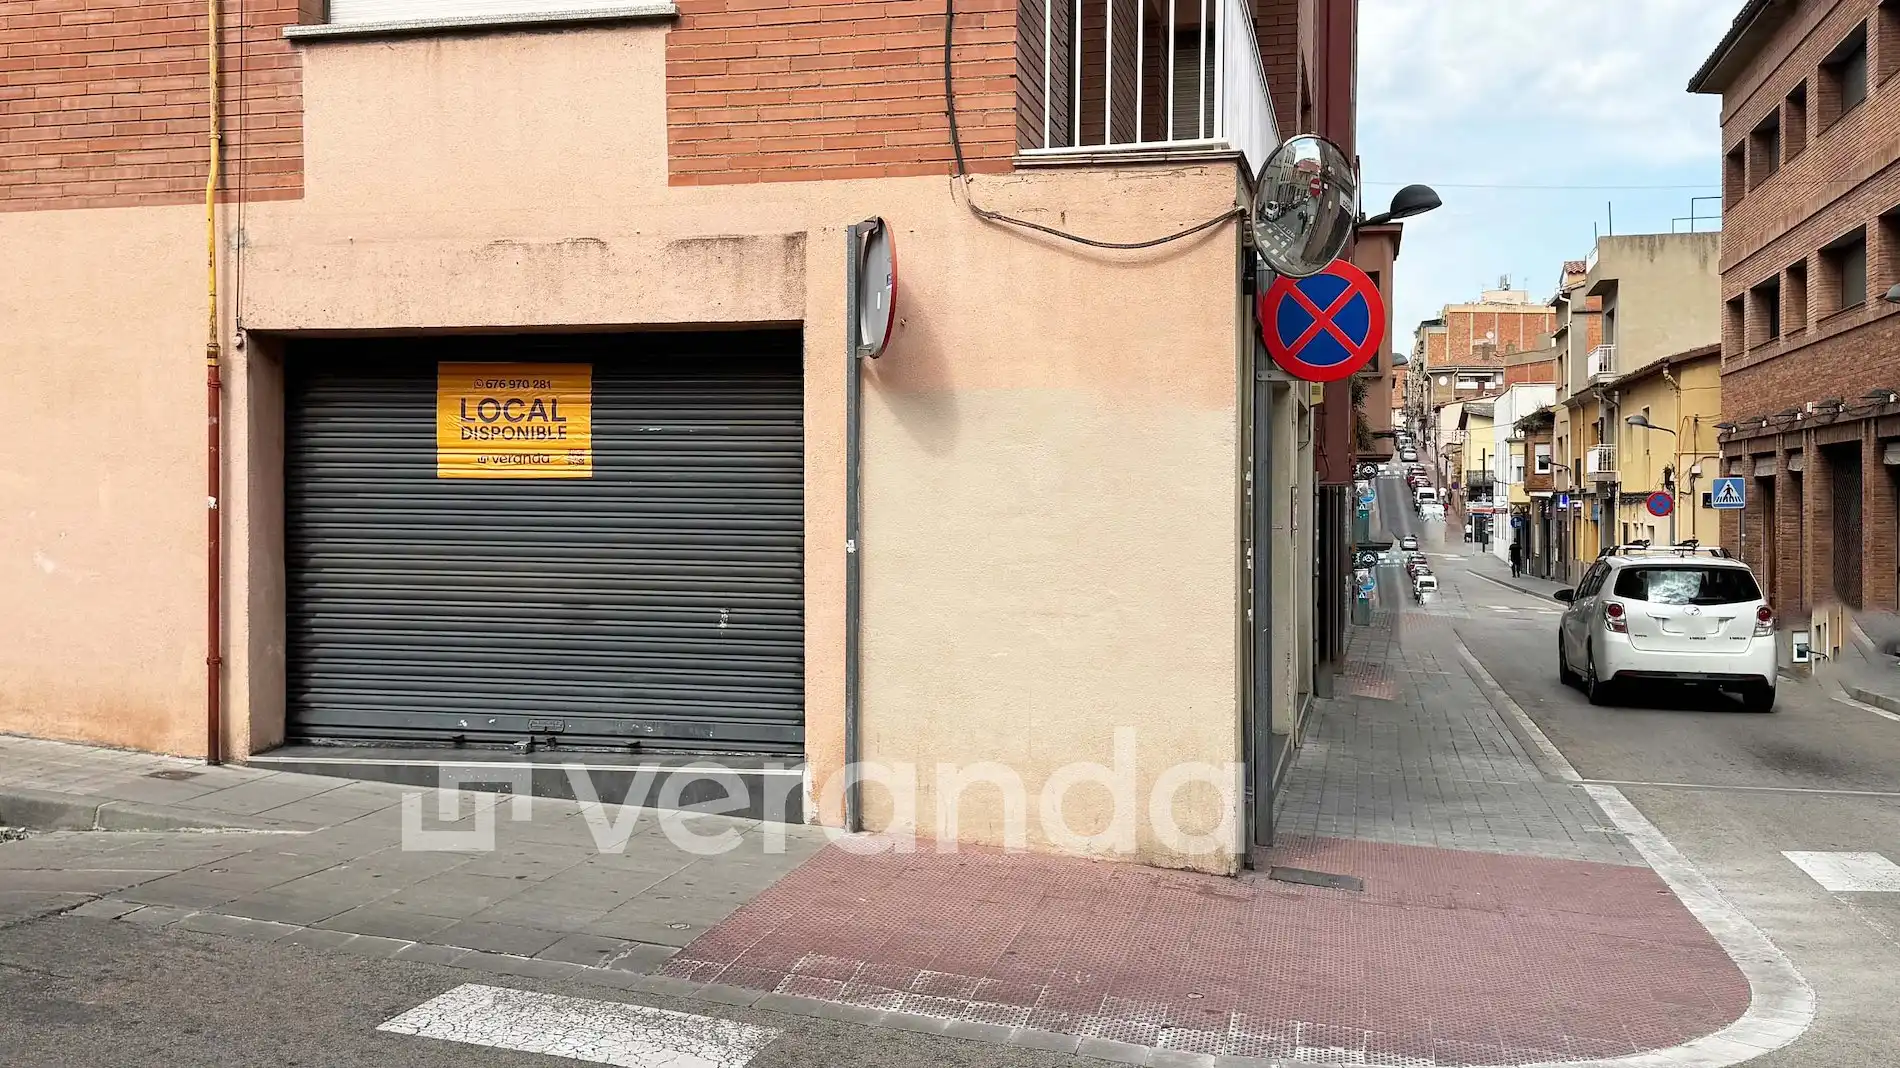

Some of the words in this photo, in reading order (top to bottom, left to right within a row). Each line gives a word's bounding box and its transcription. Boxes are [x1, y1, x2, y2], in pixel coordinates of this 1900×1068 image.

[486, 379, 506, 389] 676
[509, 379, 530, 389] 970
[533, 379, 552, 389] 281
[460, 398, 567, 423] LOCAL
[461, 426, 567, 440] DISPONIBLE
[492, 453, 550, 464] veranda
